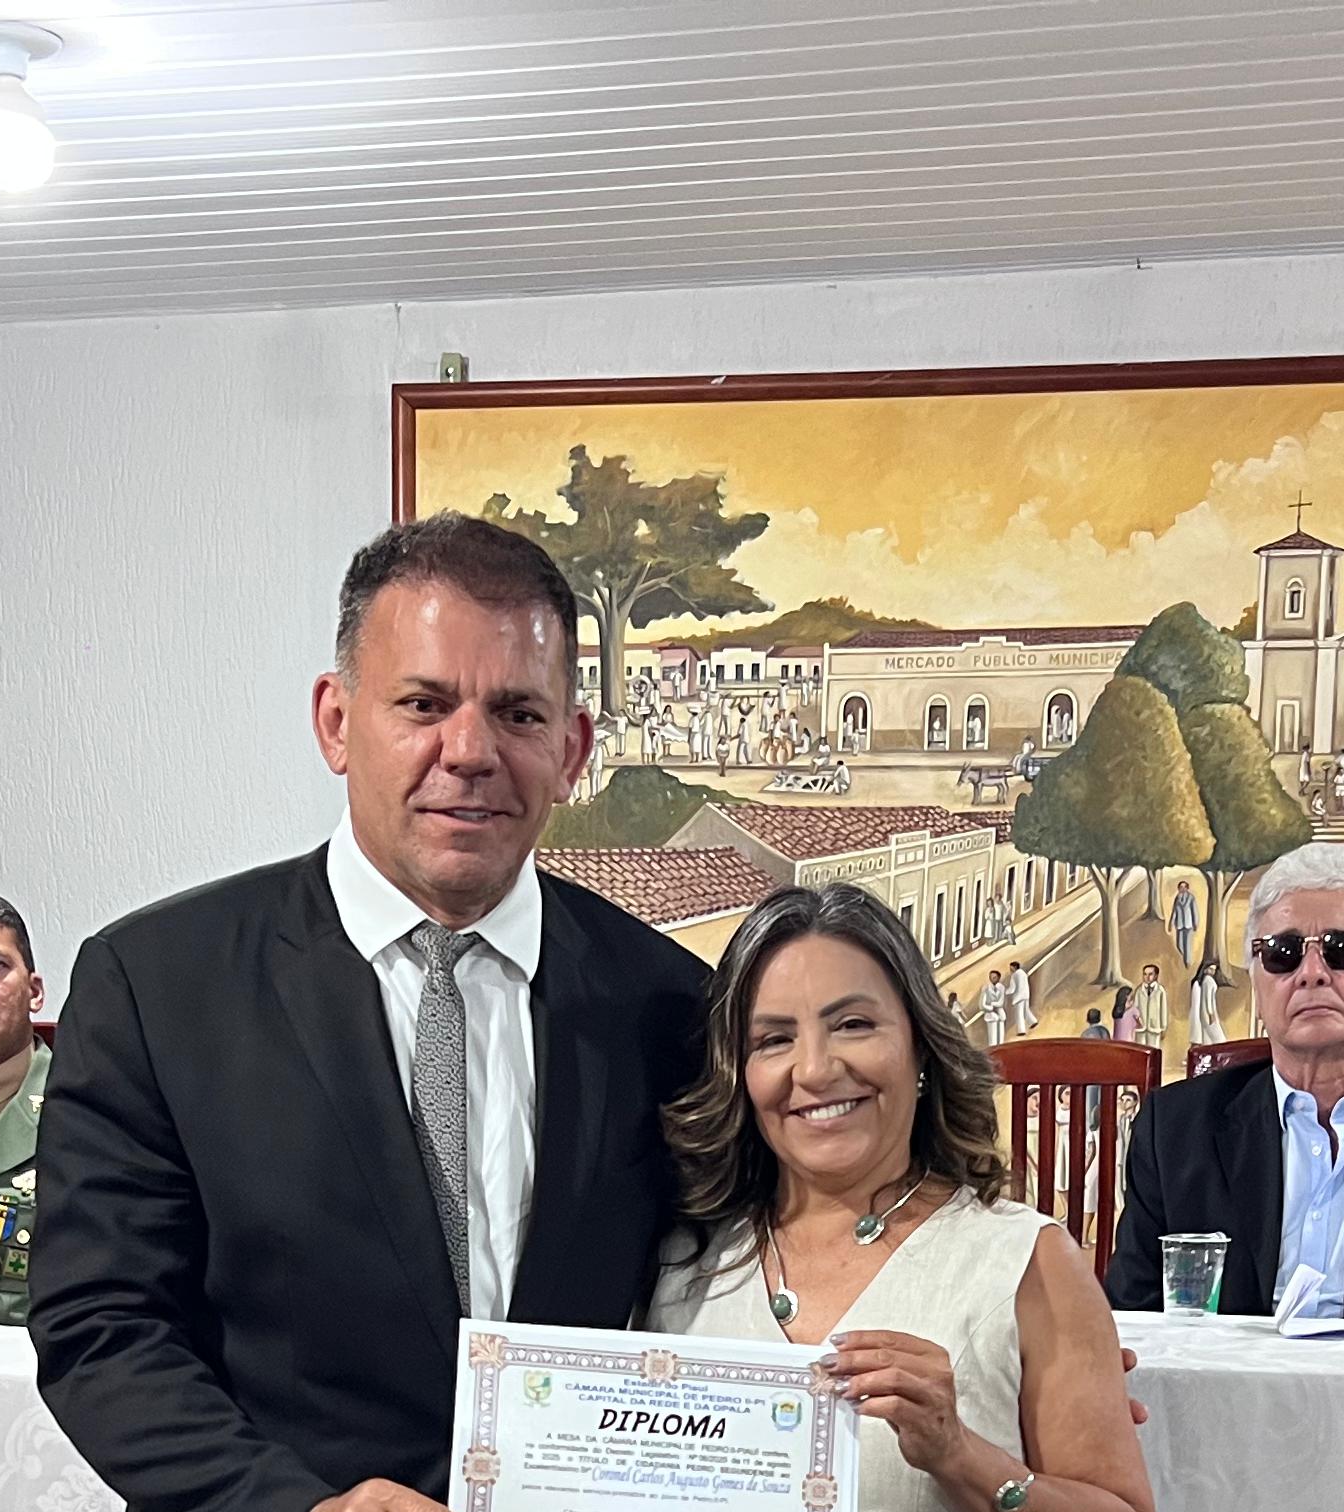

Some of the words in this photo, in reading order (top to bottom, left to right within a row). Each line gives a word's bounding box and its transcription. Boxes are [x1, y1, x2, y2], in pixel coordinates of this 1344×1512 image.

[884, 655, 955, 670] MERCADO
[973, 653, 1037, 668] PUBLICO
[1048, 651, 1123, 667] MUNICIPA
[564, 1382, 616, 1394] CÂMARA
[618, 1387, 680, 1401] MUNICIPAL
[683, 1392, 699, 1402] DE
[701, 1394, 743, 1405] PEDRO
[623, 1378, 662, 1388] Estado
[664, 1380, 679, 1390] do
[578, 1393, 626, 1405] CAPITAL
[629, 1397, 647, 1406] DA
[649, 1399, 680, 1409] REDE
[683, 1402, 691, 1410] E
[693, 1403, 710, 1411] DA
[712, 1404, 752, 1415] OPALA
[597, 1408, 727, 1440] DIPLOMA
[591, 1464, 633, 1482] Coronel
[632, 1464, 666, 1485] Carlos
[663, 1471, 711, 1492] Augusto
[712, 1474, 746, 1494] Gomes
